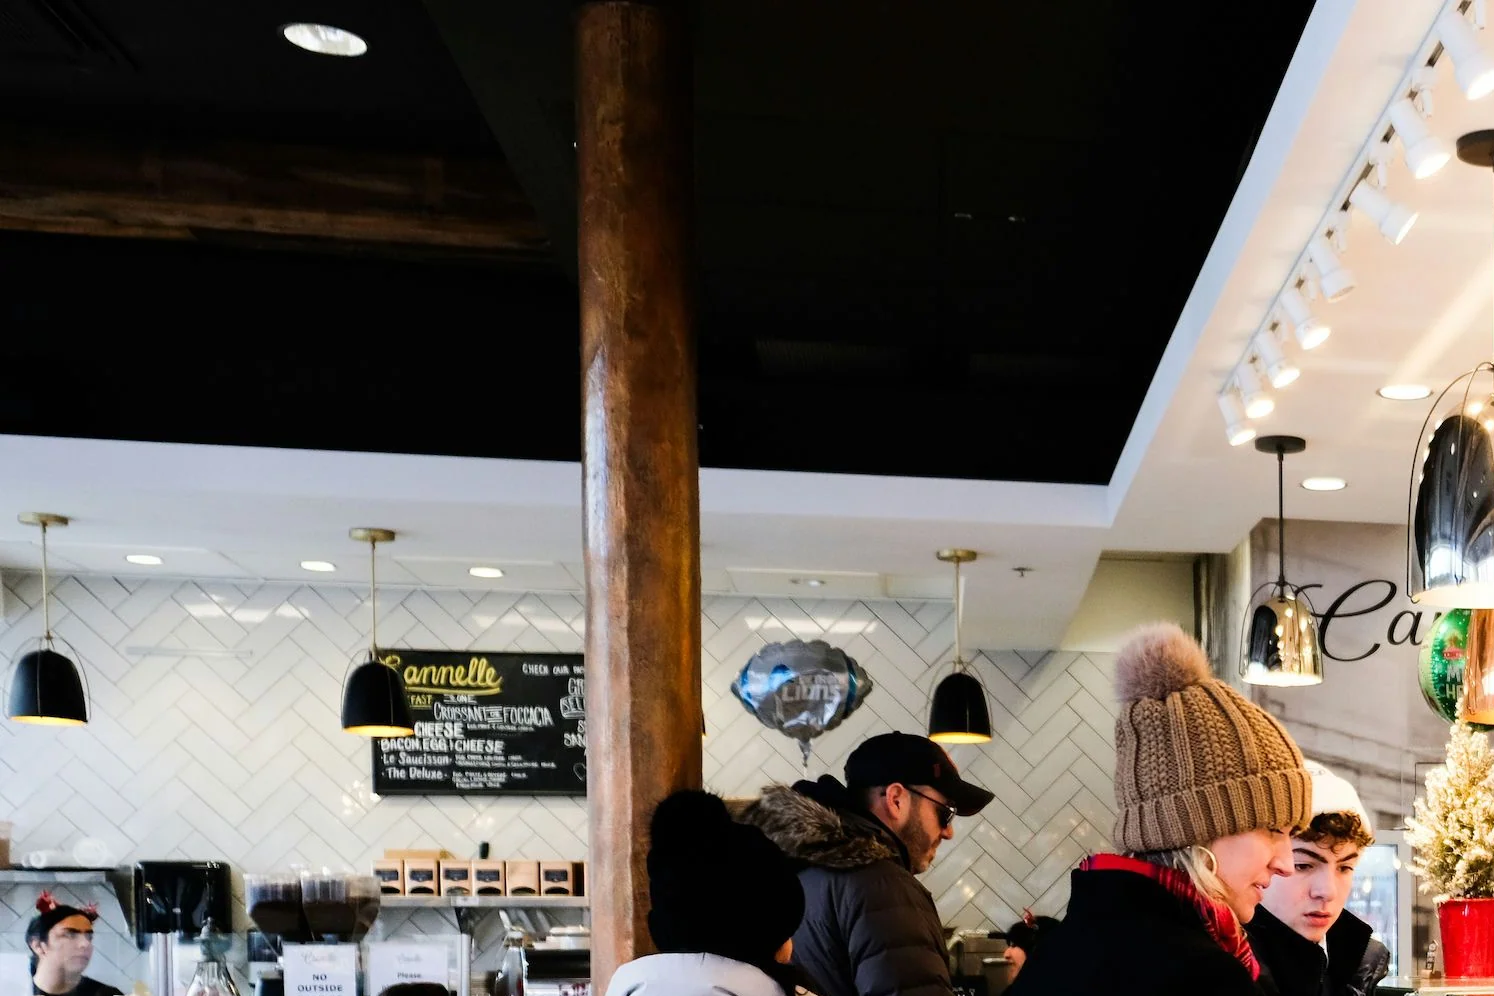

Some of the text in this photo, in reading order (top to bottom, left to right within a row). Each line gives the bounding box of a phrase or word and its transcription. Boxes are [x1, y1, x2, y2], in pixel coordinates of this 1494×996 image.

[522, 664, 549, 676] CHECK
[434, 702, 487, 722] CROISSANT
[503, 706, 554, 728] FOCCACIA
[414, 721, 465, 739] CHEESE
[423, 738, 448, 752] EGG
[455, 739, 505, 755] CHEESE
[387, 767, 407, 780] The
[409, 767, 445, 781] Deluxe
[312, 973, 328, 982] NO
[297, 985, 343, 993] OUTSIDE
